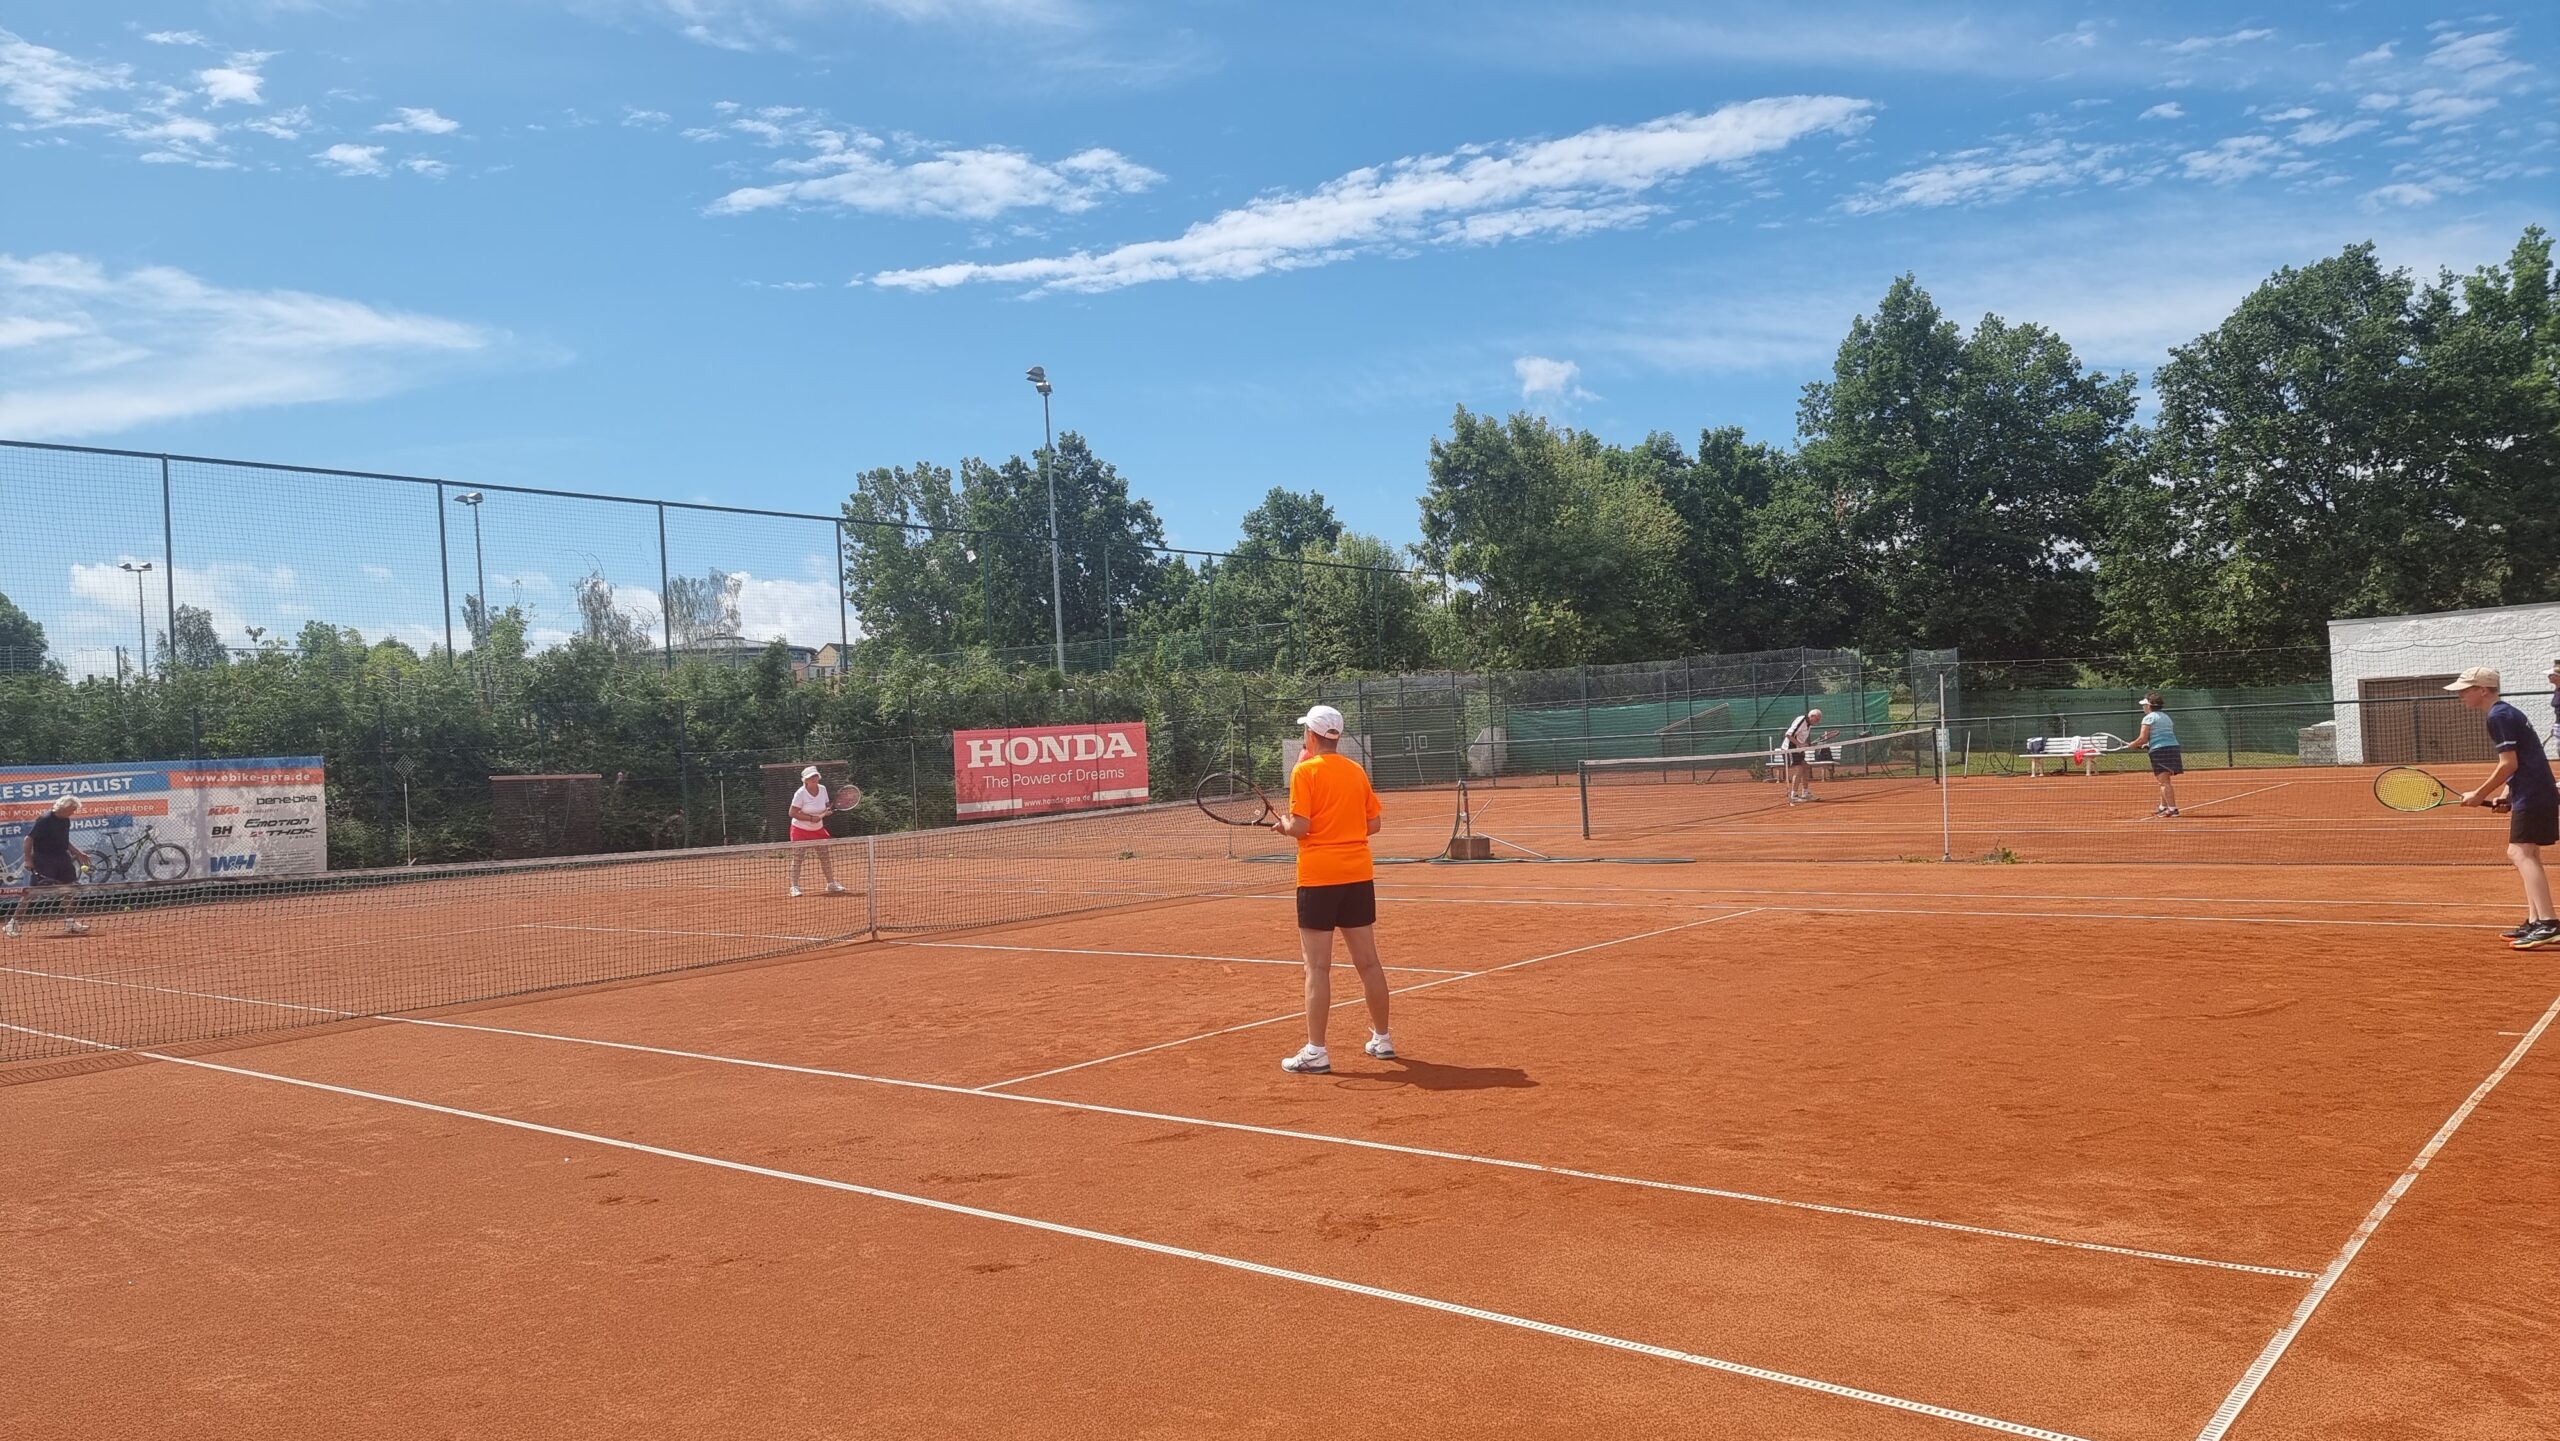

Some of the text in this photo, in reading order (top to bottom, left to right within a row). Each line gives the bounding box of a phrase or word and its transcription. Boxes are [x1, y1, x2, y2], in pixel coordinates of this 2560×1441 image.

[966, 732, 1137, 768] HONDA
[183, 772, 311, 784] www.ebike-gera.de
[983, 766, 1126, 789] The Power of Dreams
[0, 777, 133, 800] E-SPEZIALIST
[1024, 795, 1092, 807] www.honda-gera.de
[207, 805, 240, 816] KTM
[211, 825, 233, 836] BH
